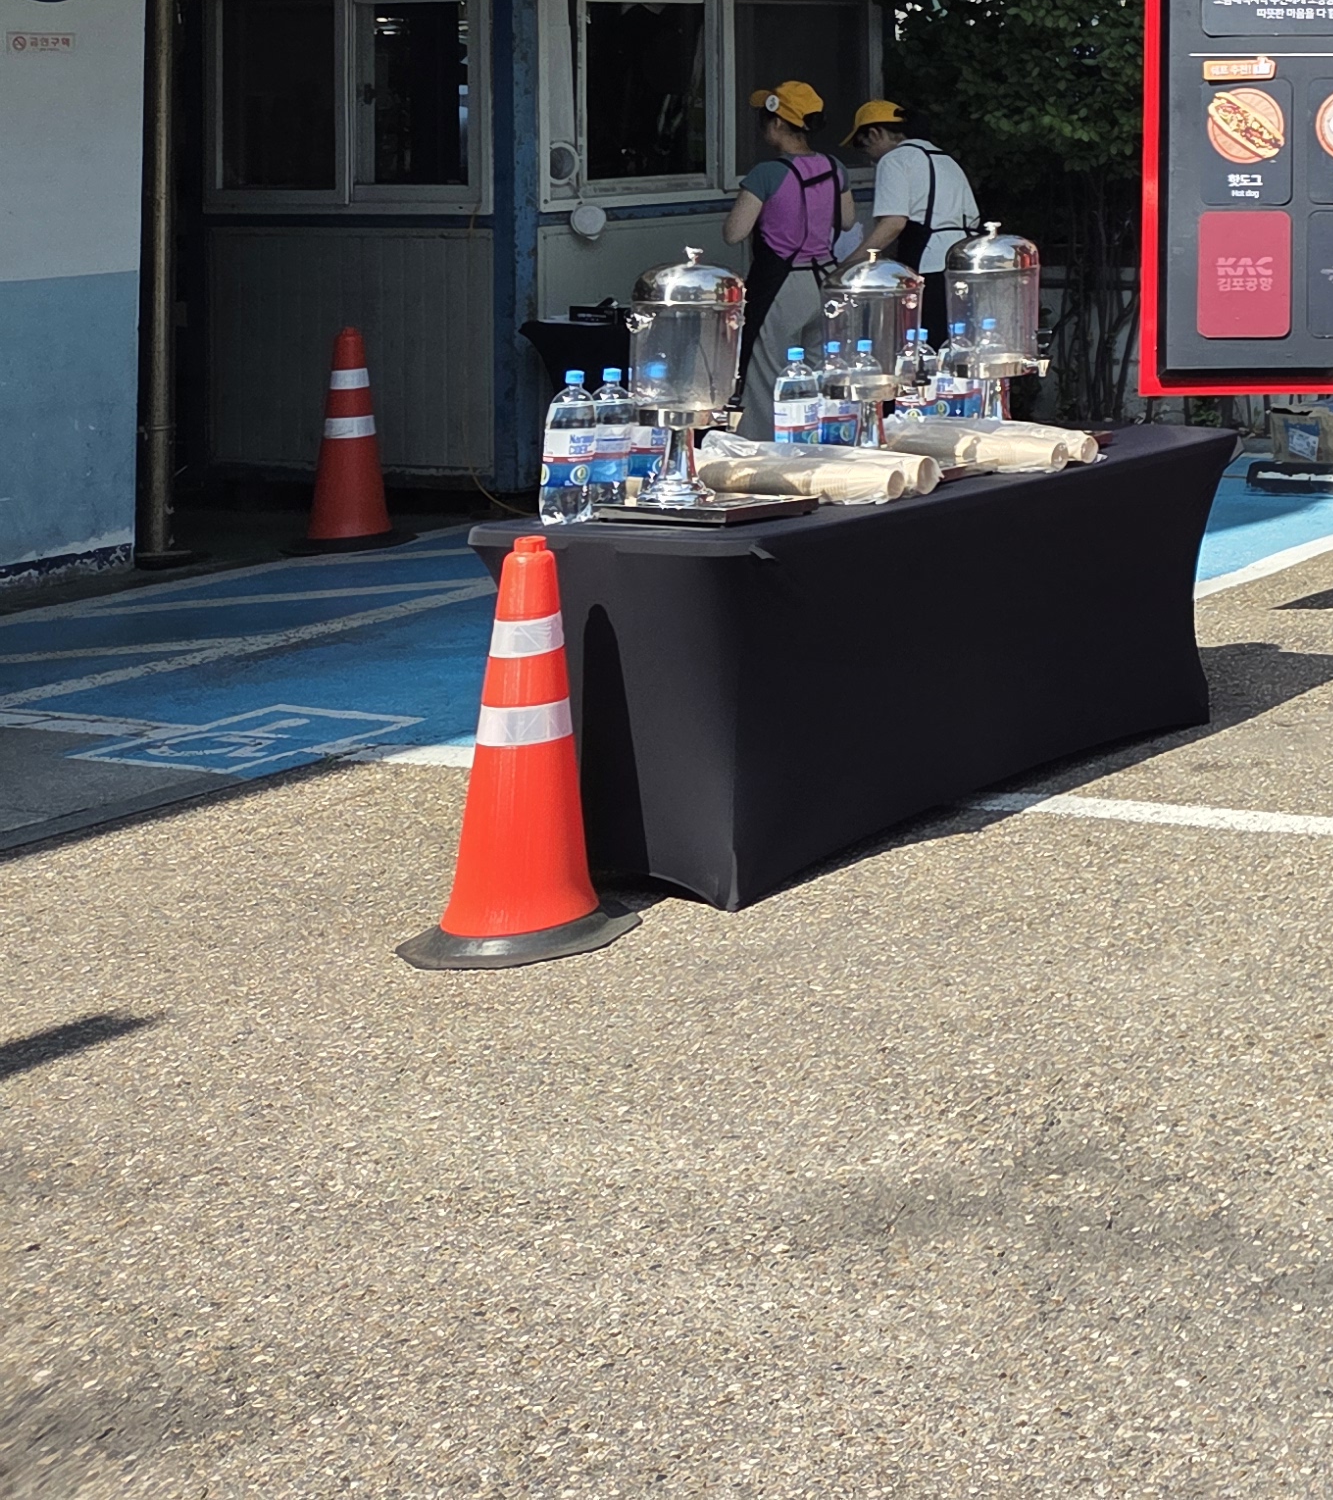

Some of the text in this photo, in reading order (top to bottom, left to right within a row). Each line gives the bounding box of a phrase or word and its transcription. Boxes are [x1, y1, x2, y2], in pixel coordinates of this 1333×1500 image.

[1256, 7, 1285, 20] 따뜻한
[1286, 7, 1314, 20] 마음을
[1316, 7, 1327, 19] 다
[1227, 173, 1263, 188] 핫도그
[1216, 256, 1273, 276] KAC
[1217, 277, 1273, 291] 김포공항
